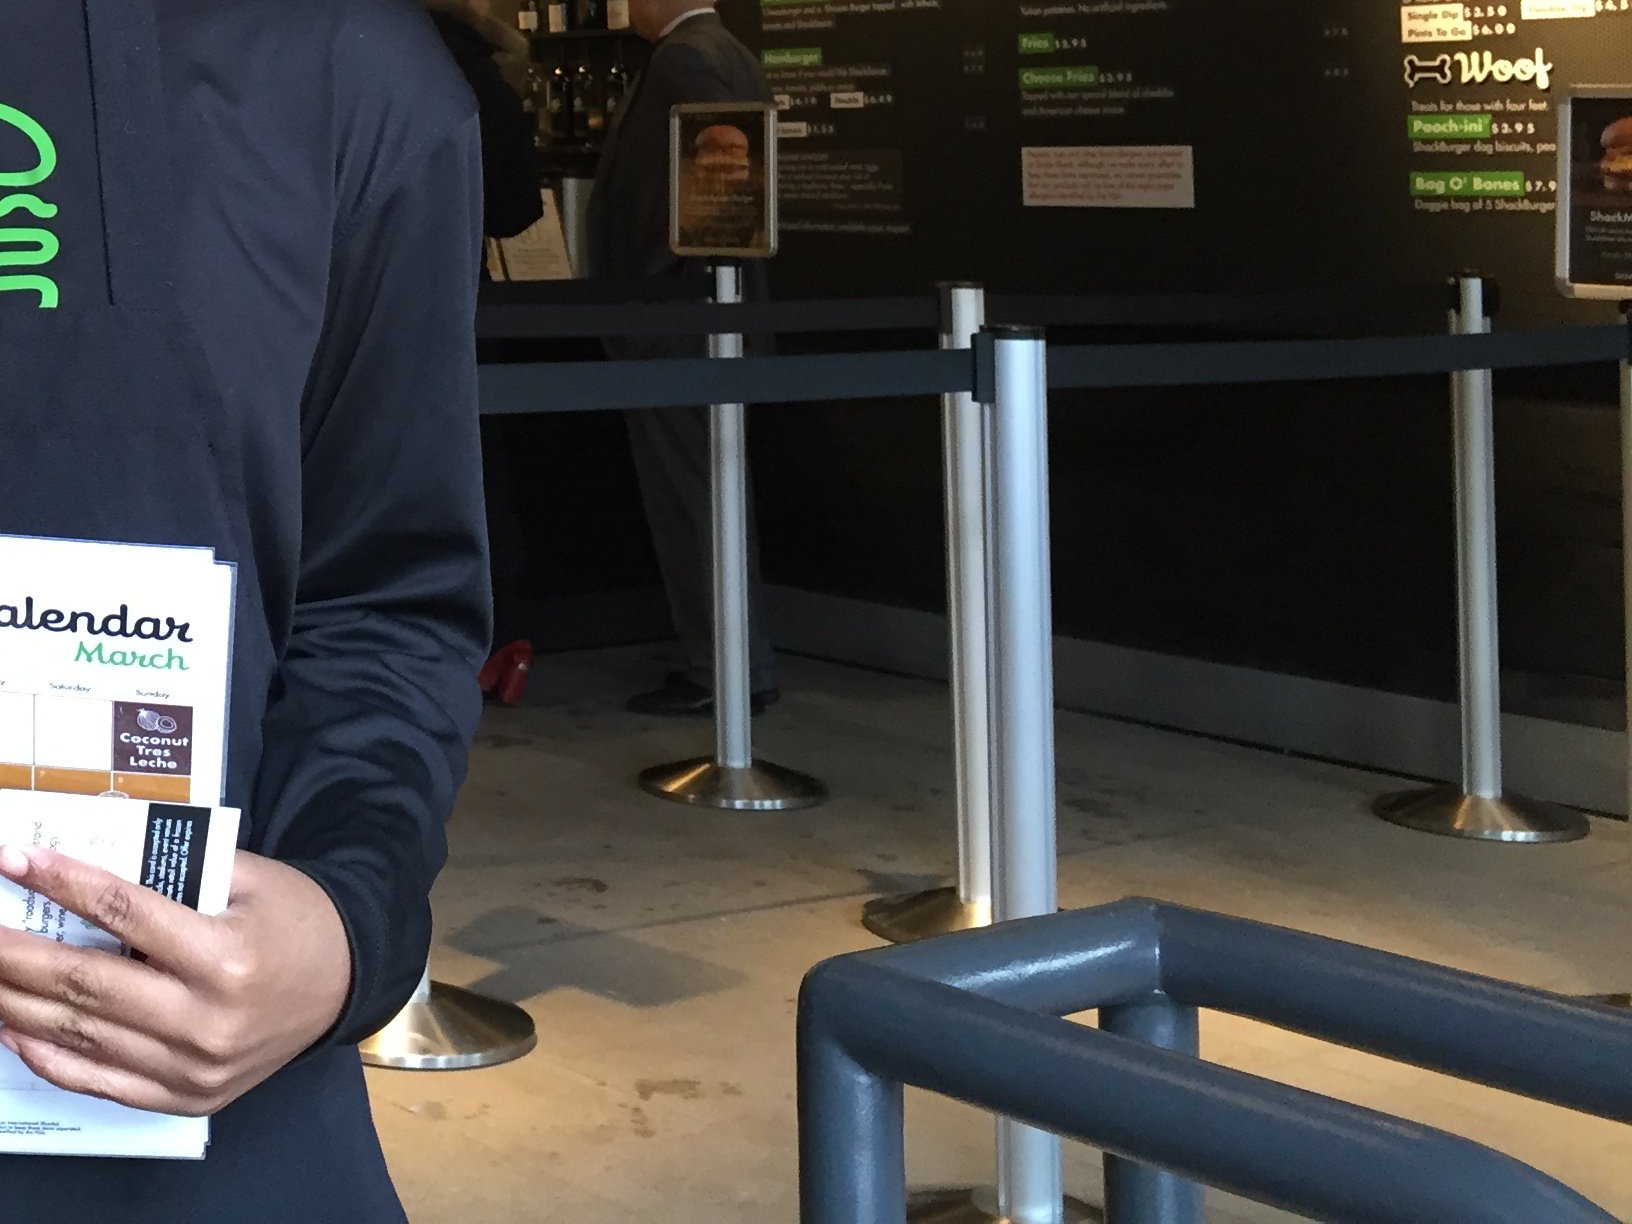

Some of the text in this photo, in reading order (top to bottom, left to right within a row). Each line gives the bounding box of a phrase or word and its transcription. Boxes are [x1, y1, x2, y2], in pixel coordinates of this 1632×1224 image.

[1407, 11, 1439, 24] Single
[1441, 10, 1459, 21] Dip
[1408, 28, 1433, 39] Pints
[1436, 27, 1448, 38] To
[1022, 37, 1049, 49] Fries
[1453, 47, 1553, 89] Woof
[1023, 70, 1095, 84] Cheese Fries
[1483, 100, 1504, 112] with
[1413, 119, 1484, 133] Pooch-ini
[1474, 140, 1494, 154] dog
[1415, 176, 1557, 194] Bag O' Bones $7.9
[1450, 199, 1471, 212] bag
[1472, 199, 1485, 210] of
[74, 641, 190, 670] March
[49, 682, 91, 694] Saturday
[135, 689, 170, 700] Sunday
[119, 732, 190, 748] Coconut
[136, 745, 171, 758] Tres
[128, 756, 178, 770] Leche
